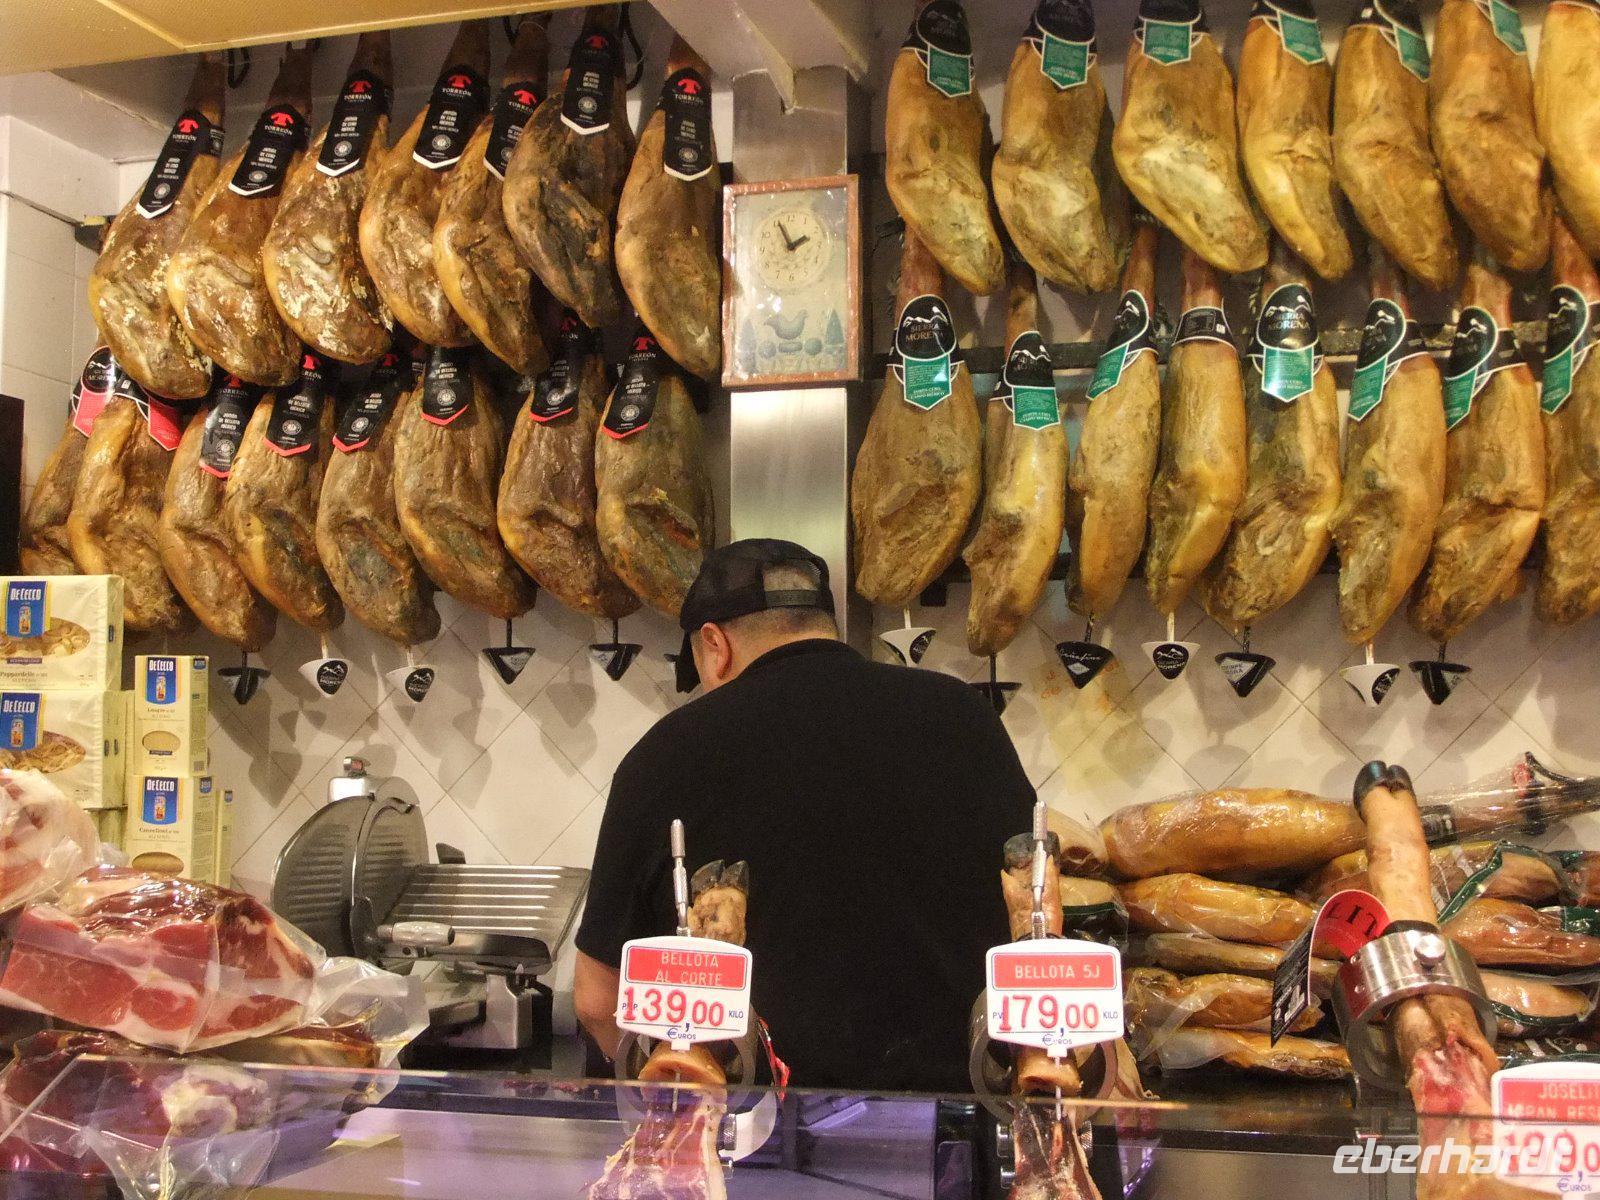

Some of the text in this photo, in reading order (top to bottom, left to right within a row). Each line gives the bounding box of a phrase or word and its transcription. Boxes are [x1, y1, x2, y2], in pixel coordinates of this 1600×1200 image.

[787, 215, 796, 223] 12
[761, 231, 771, 239] 10
[760, 246, 765, 254] 9
[764, 261, 770, 269] 8
[776, 270, 781, 279] 7
[788, 272, 795, 281] 6
[661, 951, 719, 968] BELLOTA
[1015, 964, 1100, 979] BELLOTA 5J
[655, 969, 723, 986] AL CORTE
[728, 1010, 744, 1019] KILO
[1103, 1011, 1118, 1019] KILO
